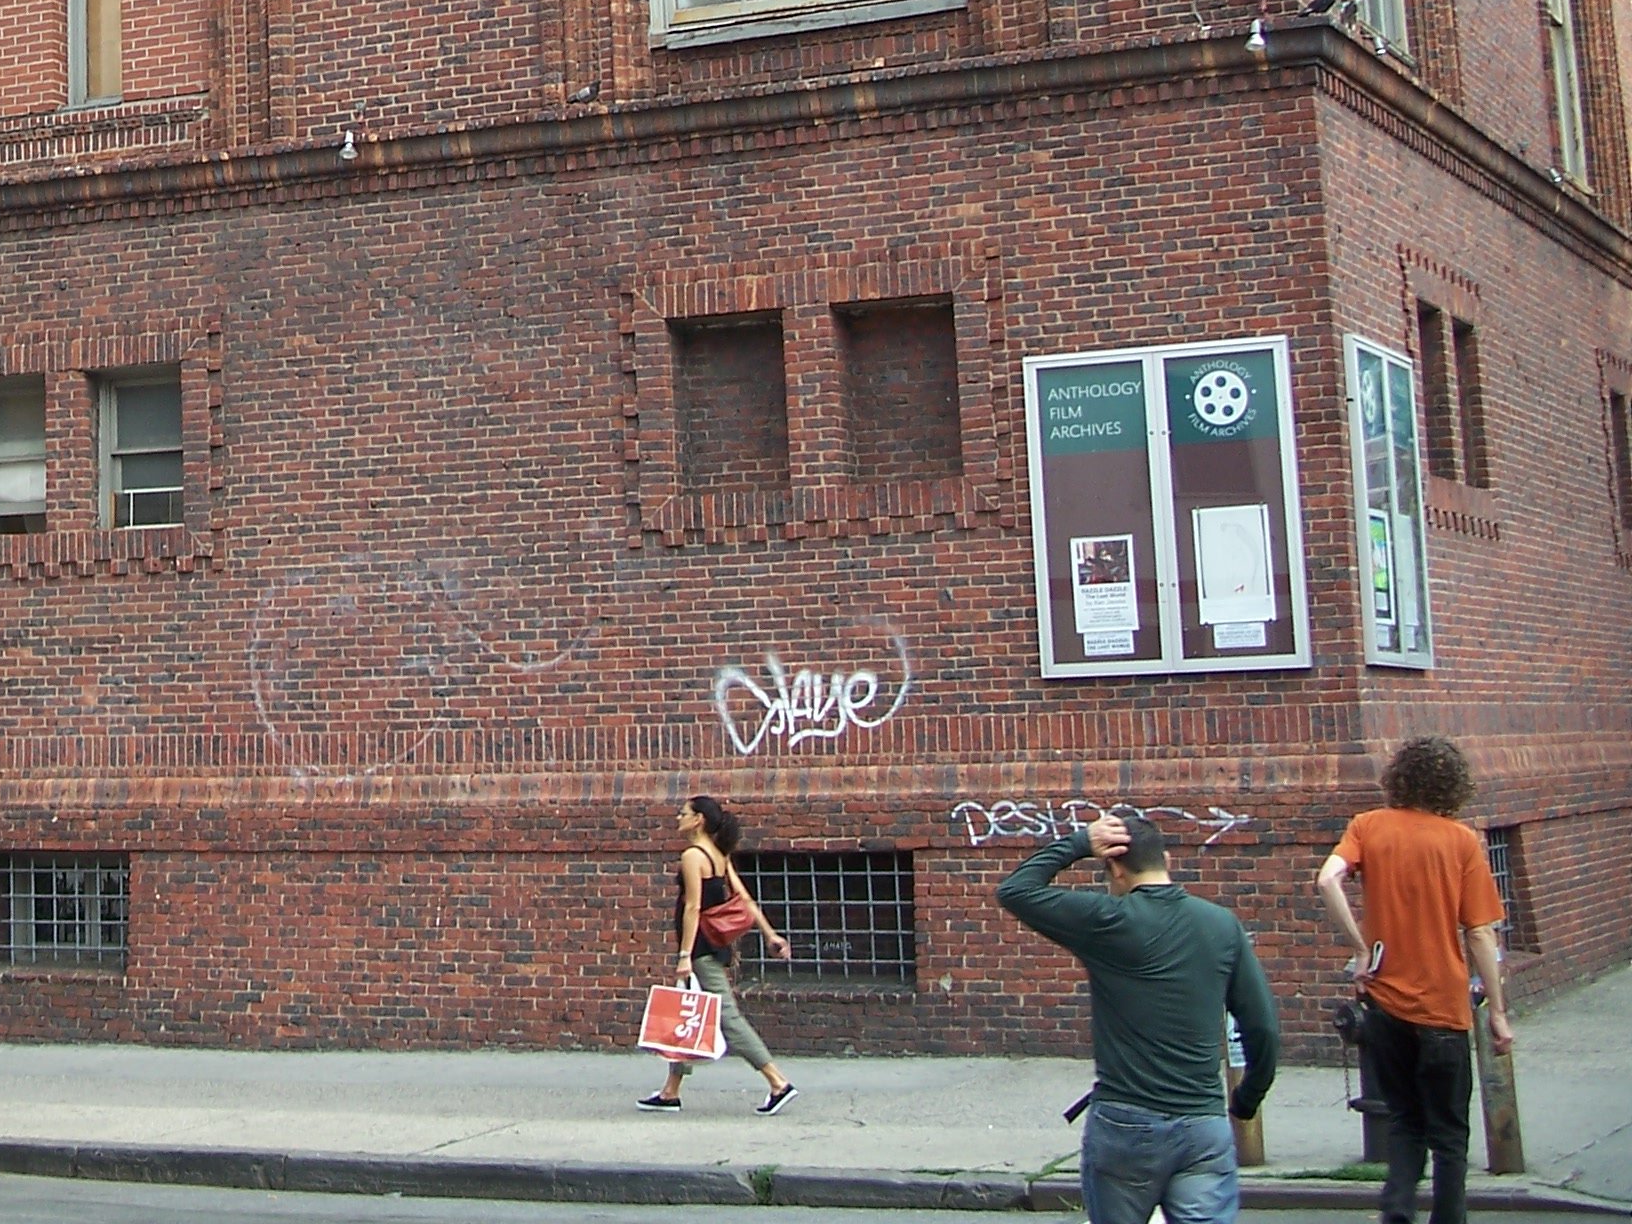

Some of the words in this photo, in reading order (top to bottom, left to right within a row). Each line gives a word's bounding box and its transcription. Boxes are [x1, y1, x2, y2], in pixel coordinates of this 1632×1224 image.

[1189, 359, 1253, 384] ANTHOLOGY
[1048, 380, 1142, 401] ANTHOLOGY
[1049, 405, 1082, 420] FILM
[1187, 412, 1210, 435] FILM
[1209, 408, 1257, 437] ARCHIVES
[1050, 420, 1122, 440] ARCHIVES
[673, 992, 701, 1039] SALE
